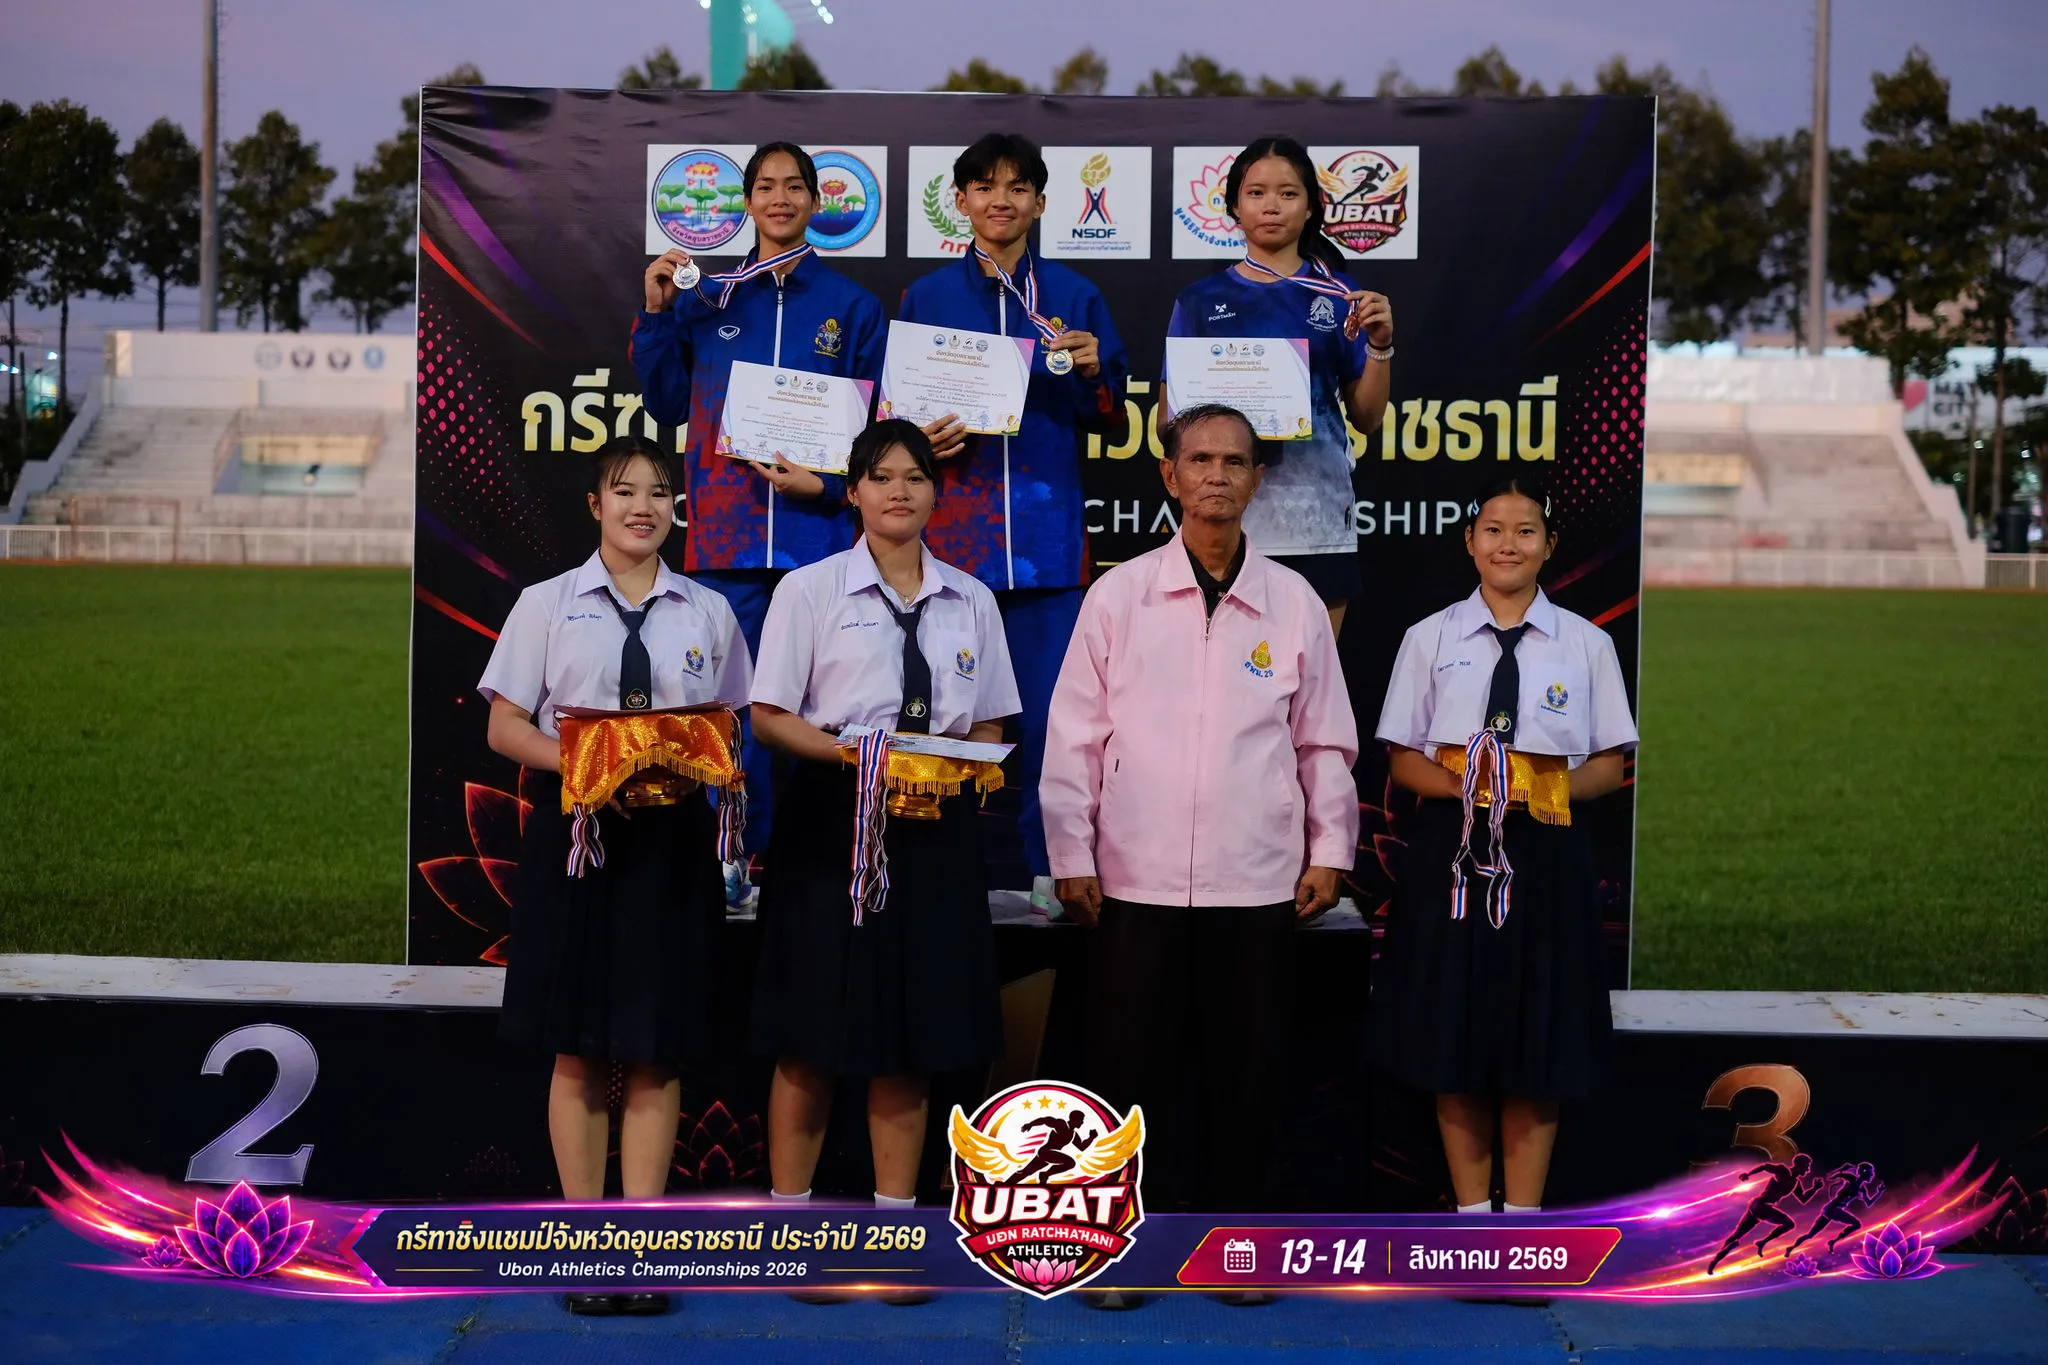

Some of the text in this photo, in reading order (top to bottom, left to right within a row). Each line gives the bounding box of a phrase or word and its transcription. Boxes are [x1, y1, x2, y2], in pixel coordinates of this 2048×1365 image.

[1323, 204, 1402, 223] UBAT
[1072, 228, 1116, 238] NSDF
[940, 239, 969, 254] กก
[185, 1023, 319, 1186] 2
[1692, 1062, 1811, 1178] 3
